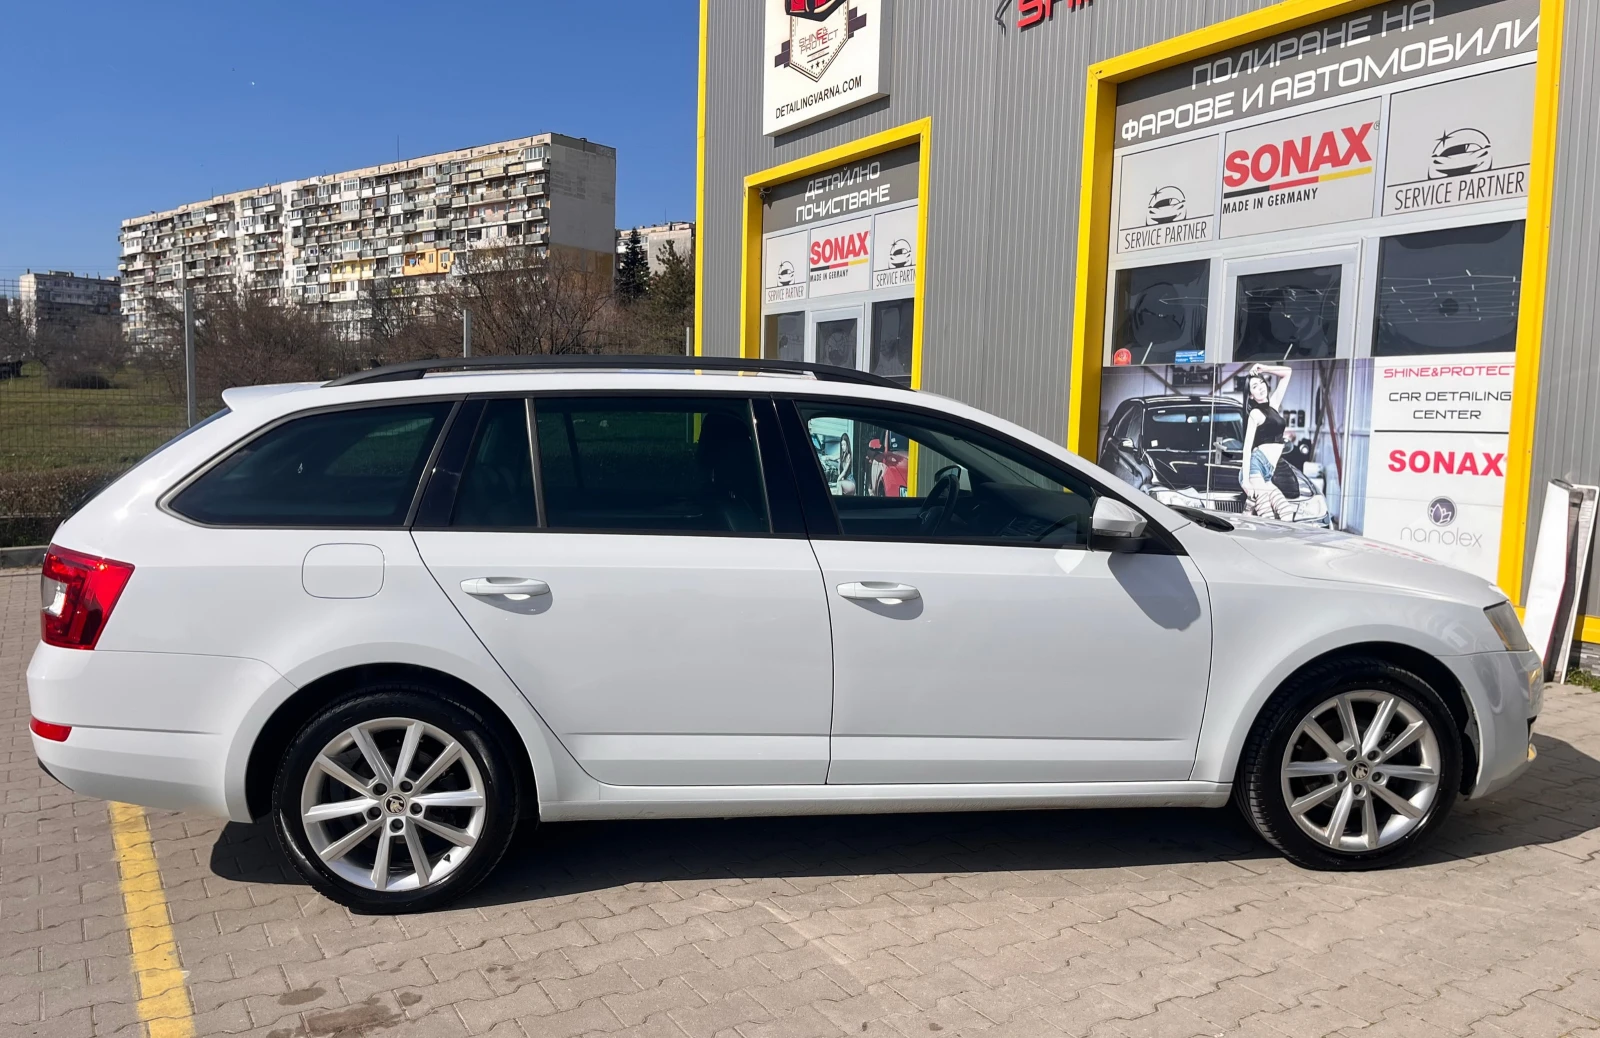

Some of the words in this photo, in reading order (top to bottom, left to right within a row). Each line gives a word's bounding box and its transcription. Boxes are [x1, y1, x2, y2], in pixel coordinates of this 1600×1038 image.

[1192, 15, 1372, 90] ПОЛИРАНЕ
[1381, 0, 1435, 38] НА
[1121, 91, 1235, 141] ФАРОВЕ
[1242, 83, 1264, 113] И
[1269, 14, 1540, 106] АВТОМОБИЛИ
[775, 75, 862, 119] DETAILINGVARNA.COM
[1223, 122, 1374, 188] SONAX
[805, 162, 880, 201] ДЕТАЙЛНО
[1394, 182, 1453, 211] SERVICE
[1457, 171, 1525, 202] PARTNER
[796, 184, 890, 222] ПОЧИСТВАНЕ
[1222, 200, 1249, 215] MADE
[1253, 197, 1264, 209] IN
[1267, 188, 1318, 208] GERMANY
[810, 231, 869, 265] SONAX
[1124, 227, 1162, 250] SERVICE
[1164, 221, 1207, 244] PARTNER
[810, 273, 822, 283] MADE
[822, 272, 828, 280] IN
[828, 269, 849, 279] GERMANY
[876, 270, 898, 287] SERVICE
[768, 288, 785, 302] SERVICE
[785, 286, 804, 299] PARTNER
[1389, 392, 1422, 402] CAR
[1425, 391, 1512, 402] DETAILING
[1413, 410, 1482, 420] CENTER
[1388, 450, 1505, 477] SONAX
[1400, 527, 1483, 549] nanolex
